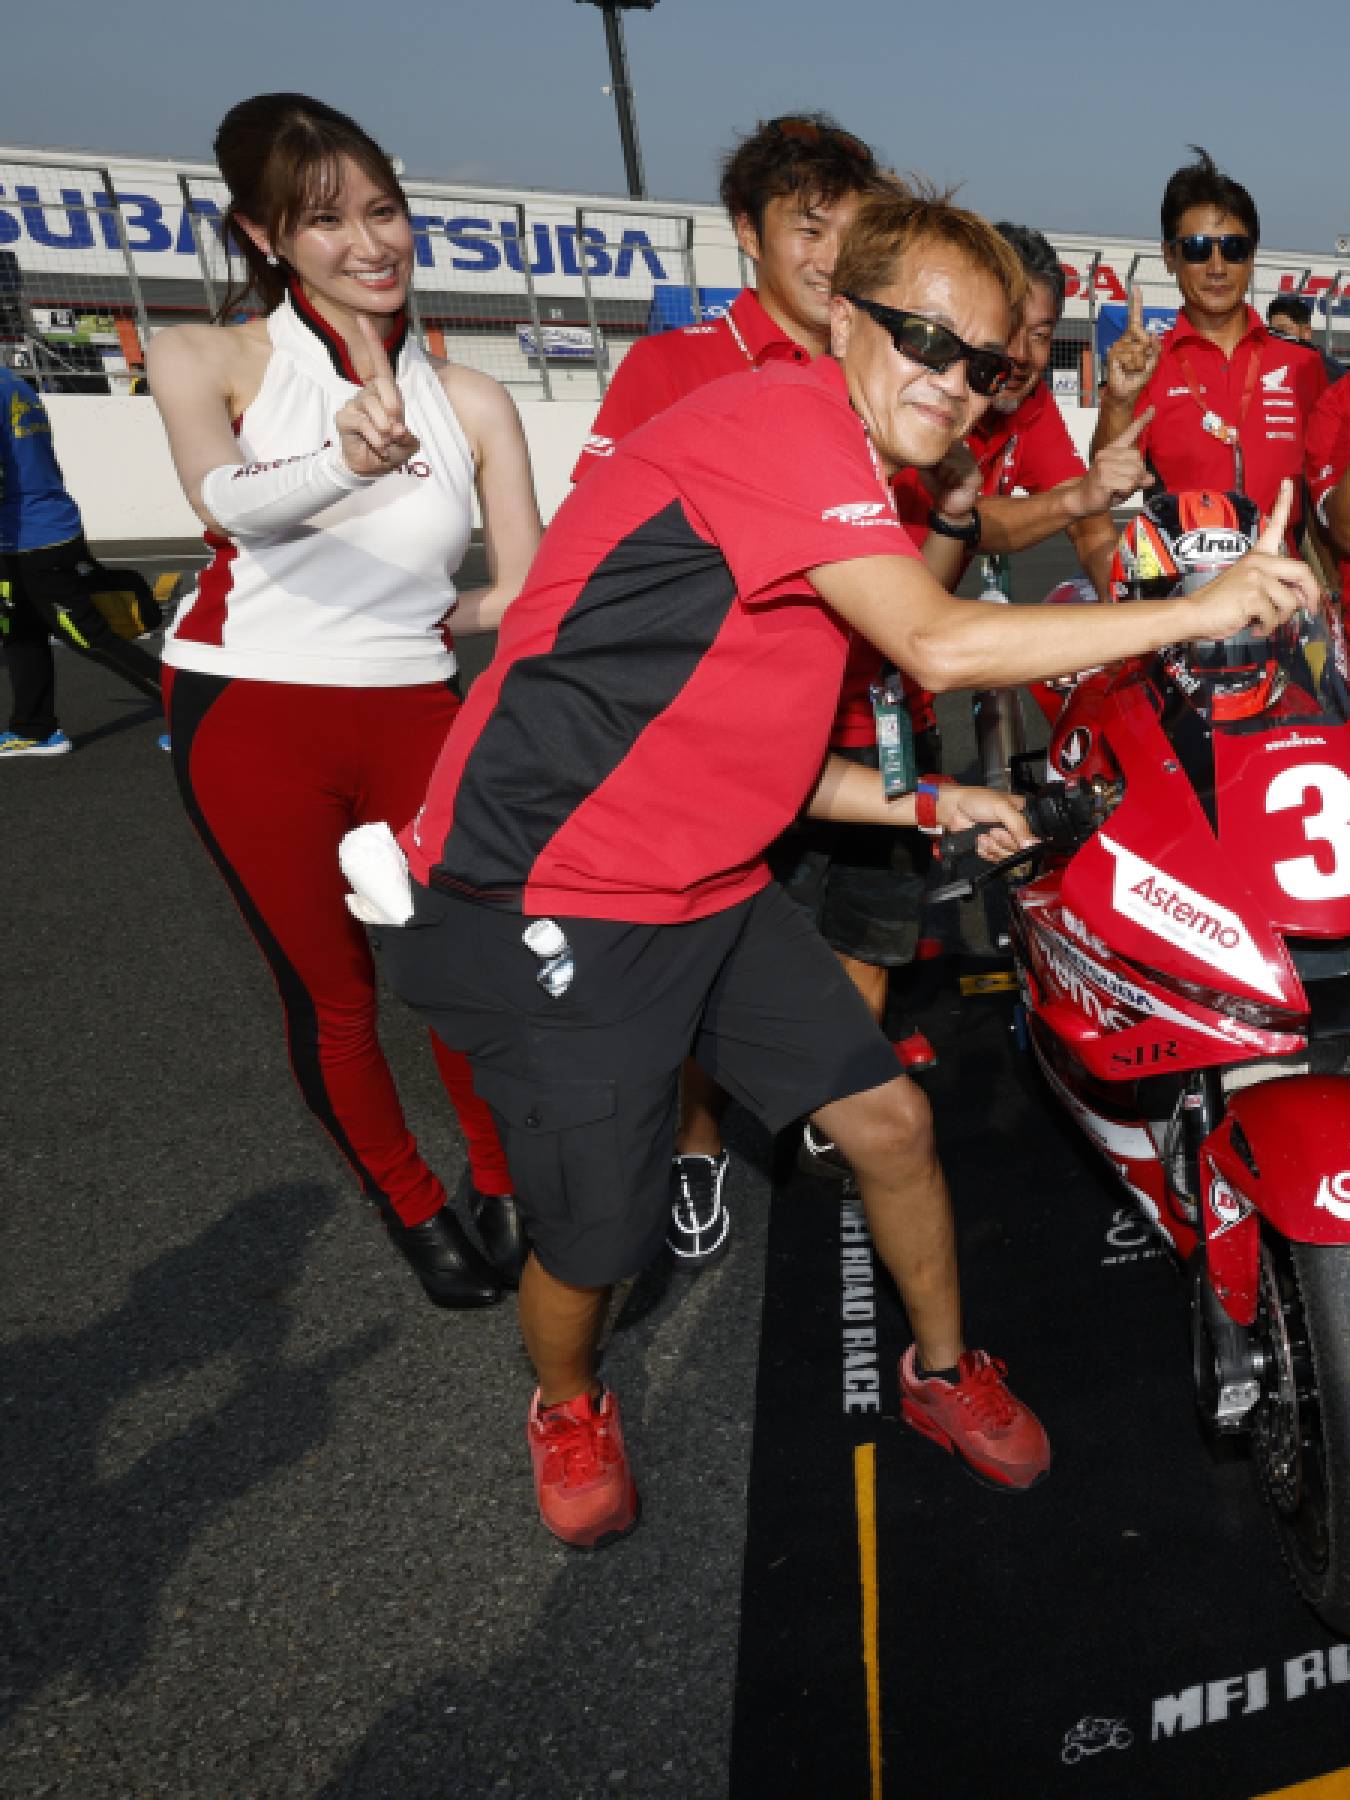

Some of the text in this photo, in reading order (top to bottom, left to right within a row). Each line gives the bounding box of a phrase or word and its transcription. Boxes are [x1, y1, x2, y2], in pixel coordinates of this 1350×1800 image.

[1130, 875, 1241, 949] Astemo
[841, 1247, 875, 1322] ROAD
[842, 1327, 880, 1414] RACE
[1152, 1667, 1268, 1741] MFJ
